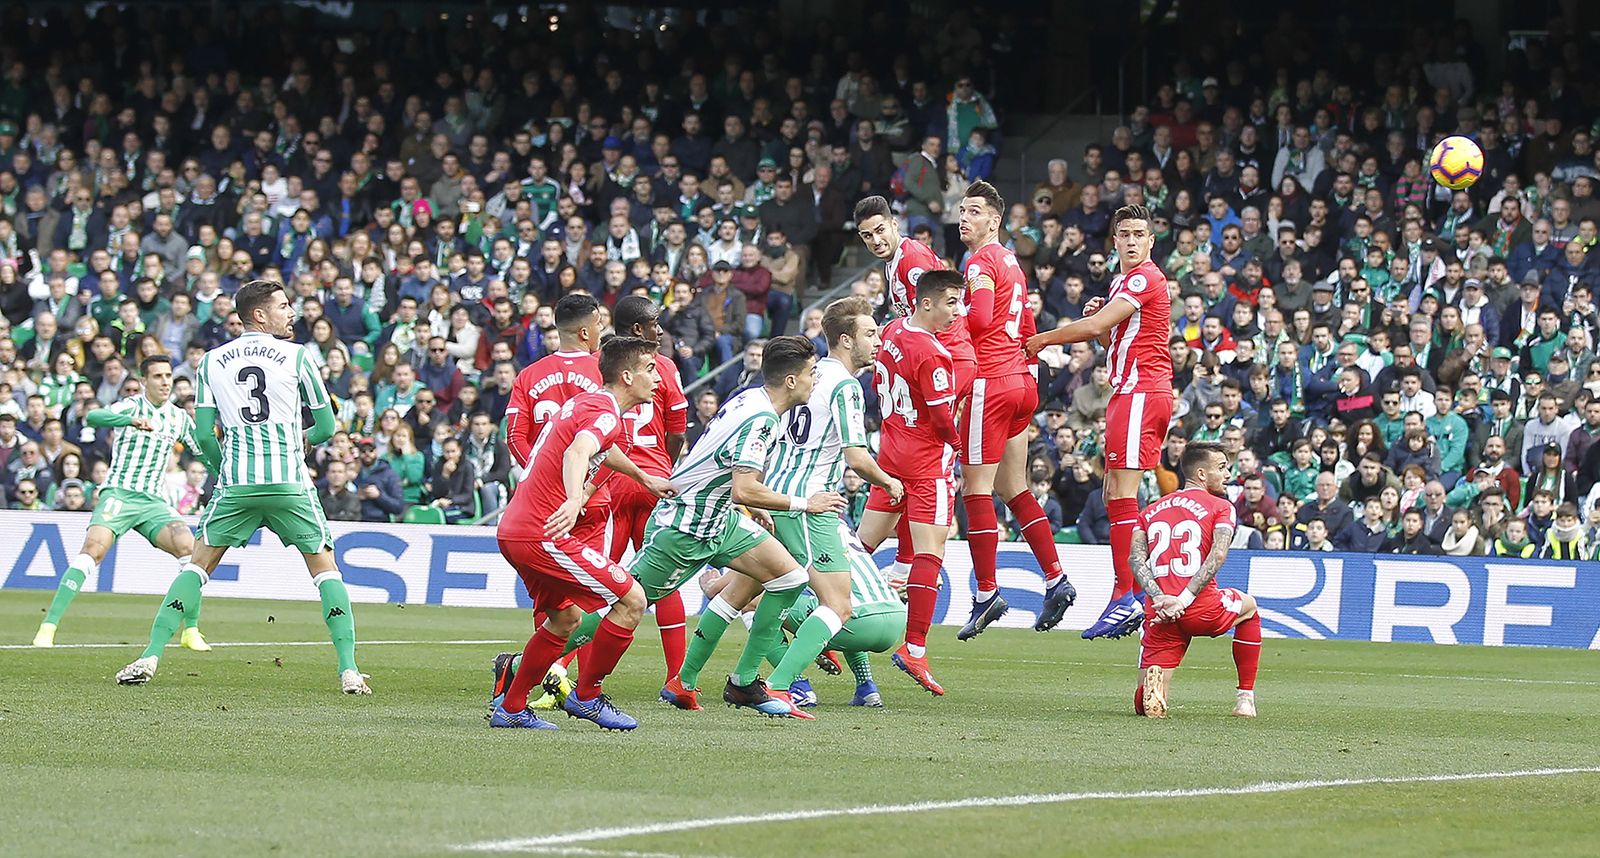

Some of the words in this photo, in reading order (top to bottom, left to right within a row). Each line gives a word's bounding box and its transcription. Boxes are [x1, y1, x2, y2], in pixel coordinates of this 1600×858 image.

[217, 348, 240, 369] JAVI
[244, 346, 287, 366] GARCIA
[235, 366, 270, 425] 3
[528, 371, 564, 400] PEDRO
[567, 371, 599, 394] PORR
[875, 361, 918, 427] 34
[1144, 500, 1173, 522] ALEIX
[1171, 496, 1209, 521] GARCIA
[581, 547, 608, 569] 8
[1146, 519, 1203, 579] 23
